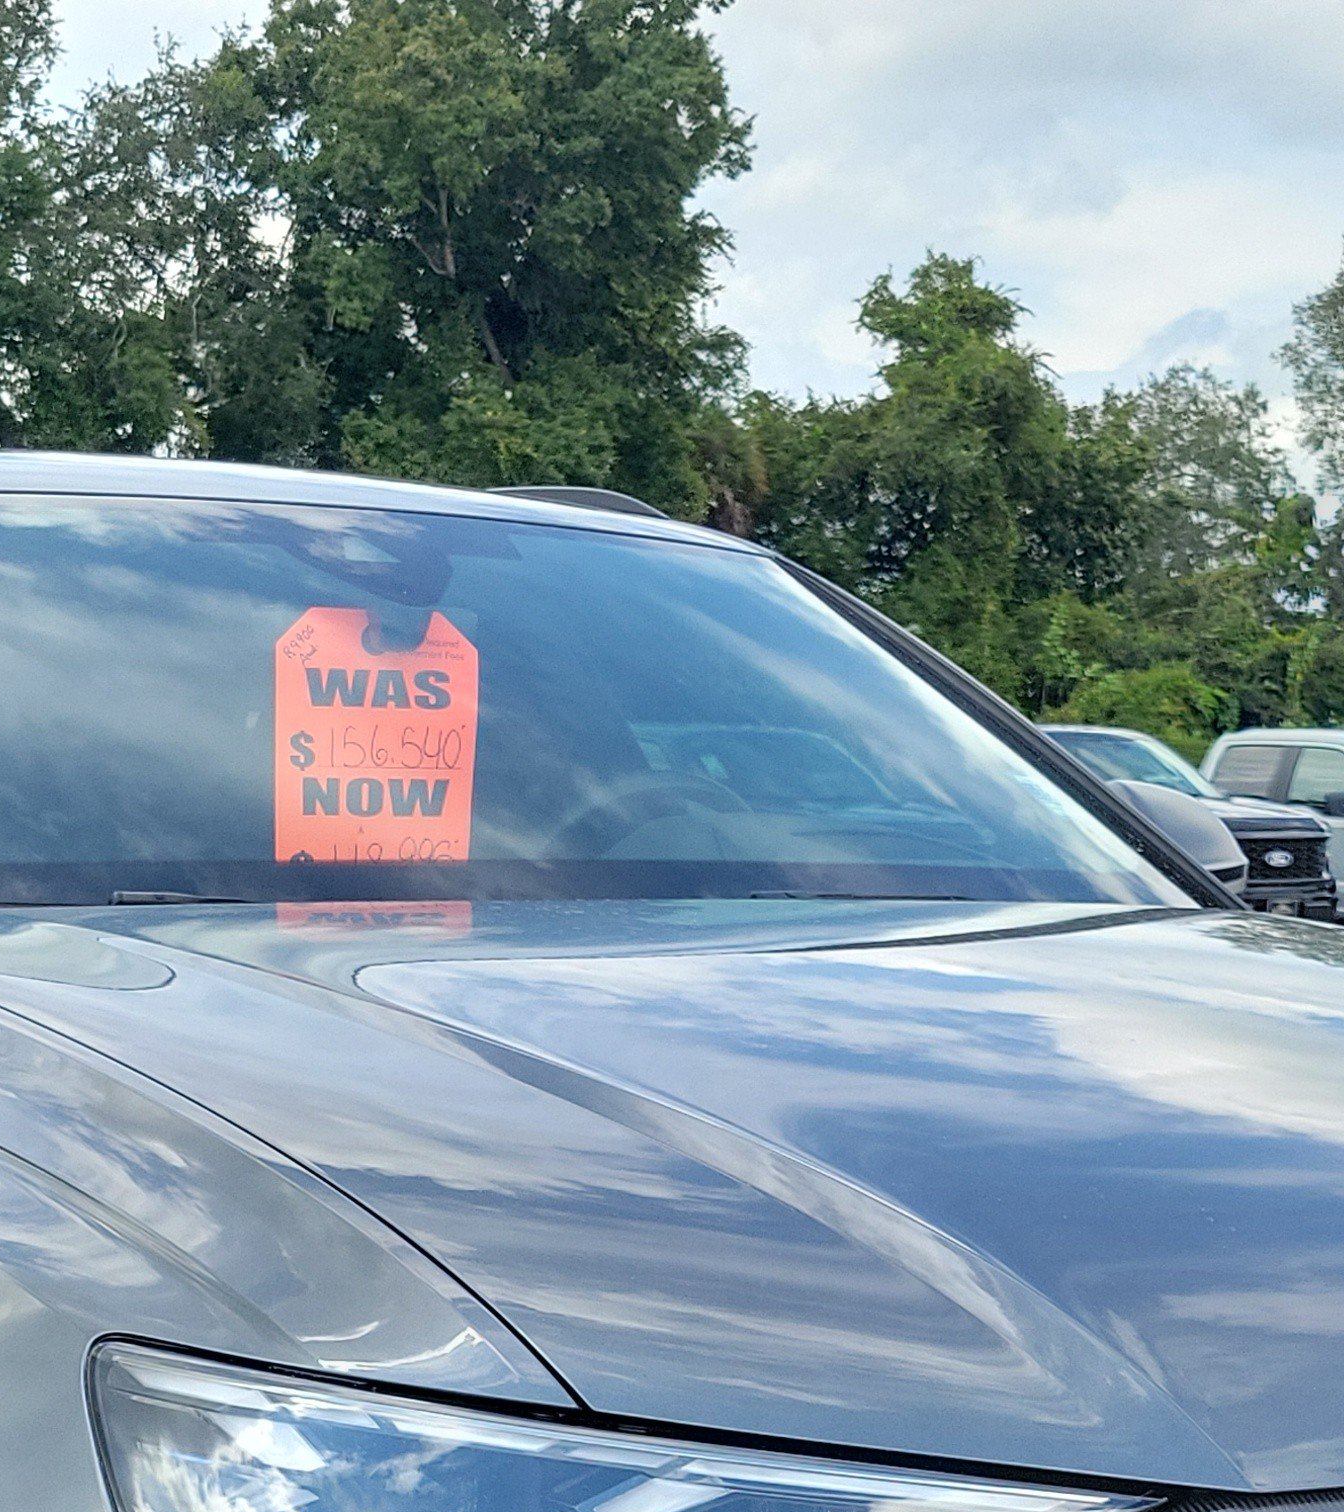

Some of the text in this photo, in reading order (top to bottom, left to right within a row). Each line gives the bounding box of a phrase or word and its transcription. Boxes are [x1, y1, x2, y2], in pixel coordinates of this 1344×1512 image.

[305, 667, 452, 710] WAS
[289, 730, 316, 771] $
[302, 777, 451, 818] NOW
